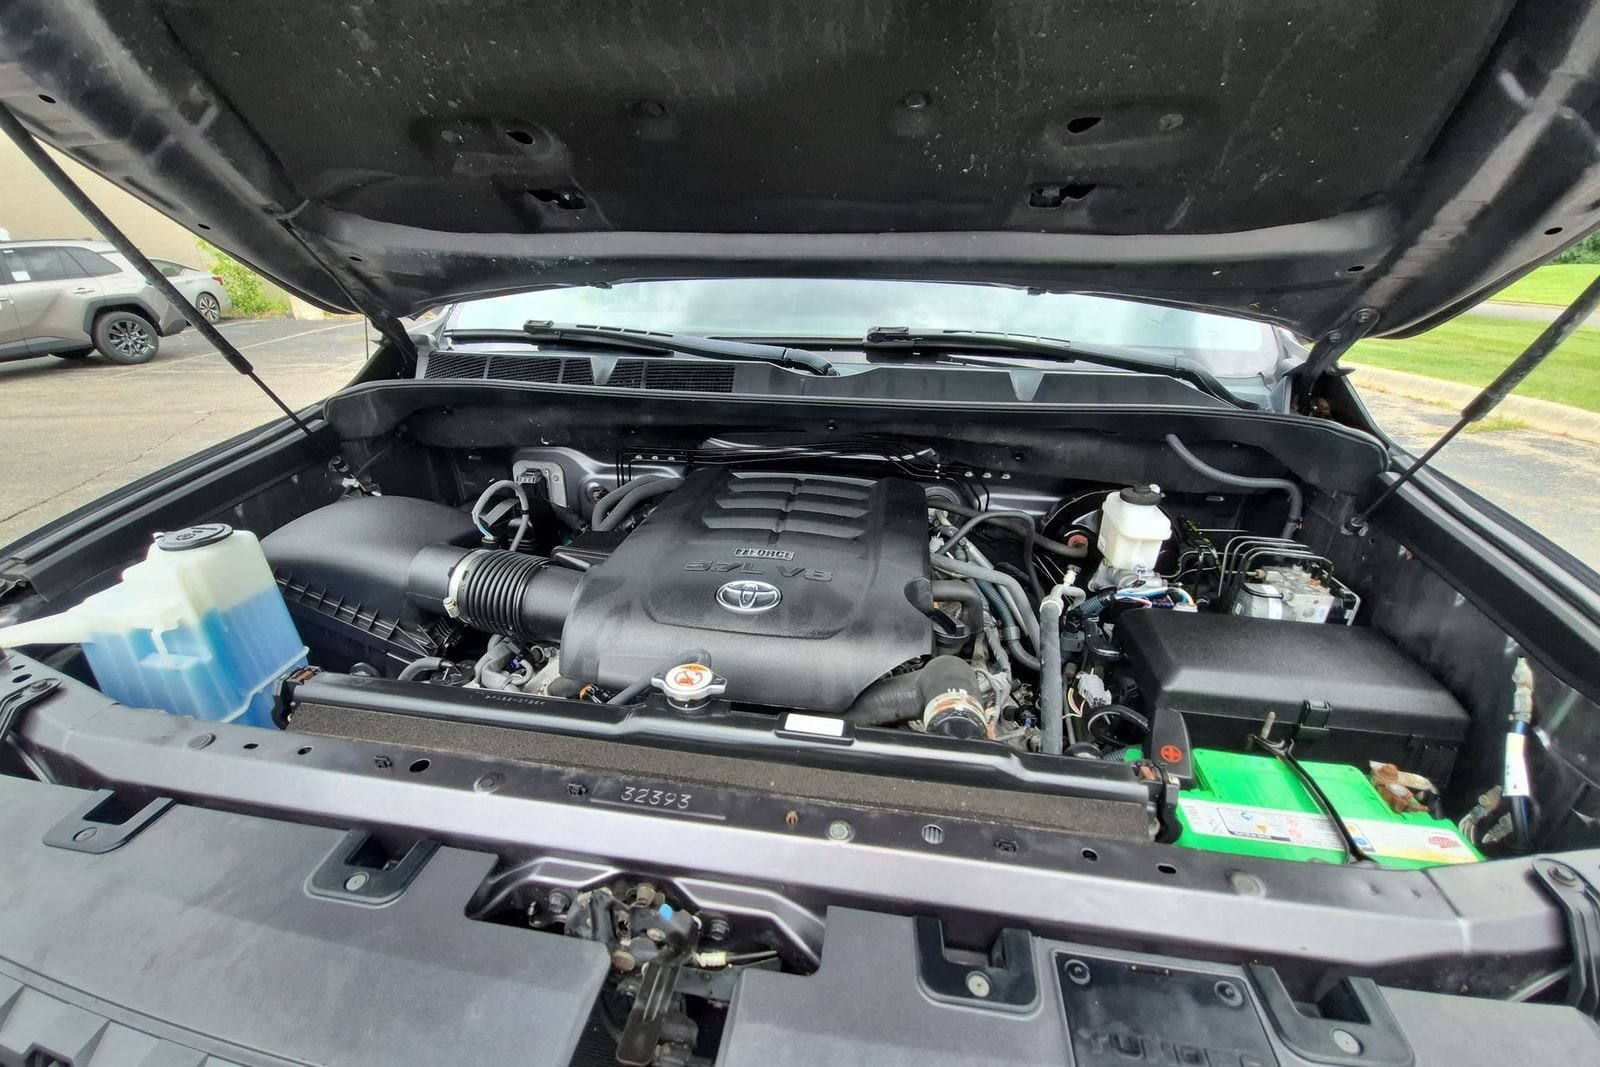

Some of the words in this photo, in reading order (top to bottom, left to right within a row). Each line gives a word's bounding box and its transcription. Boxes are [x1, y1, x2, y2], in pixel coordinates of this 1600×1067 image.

[684, 560, 766, 575] 5.7L
[776, 566, 834, 582] V8
[620, 786, 692, 809] 32393
